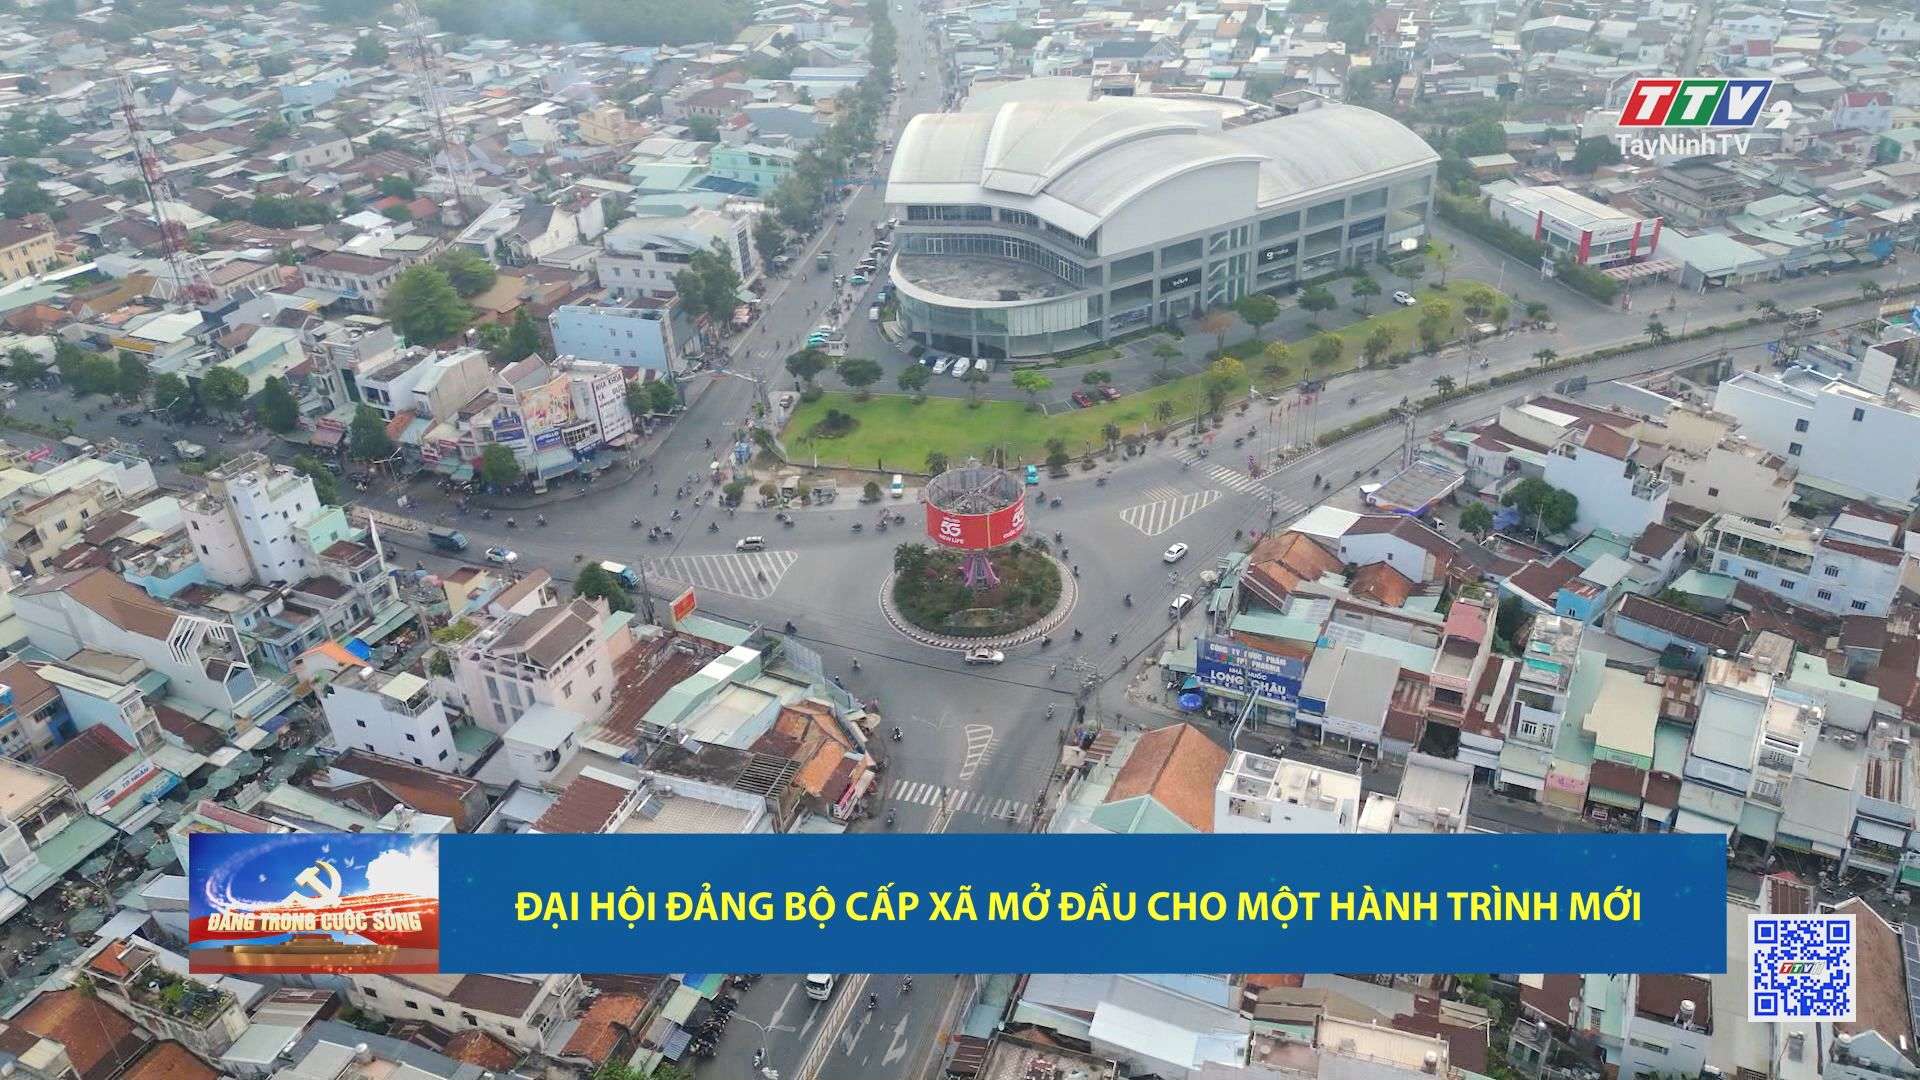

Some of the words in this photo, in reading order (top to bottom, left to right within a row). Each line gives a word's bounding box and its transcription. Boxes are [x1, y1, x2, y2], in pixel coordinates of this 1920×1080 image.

[940, 519, 961, 537] 5G
[1251, 660, 1281, 673] PHARMA
[1210, 669, 1245, 685] LONG
[1250, 679, 1286, 695] CHÂU
